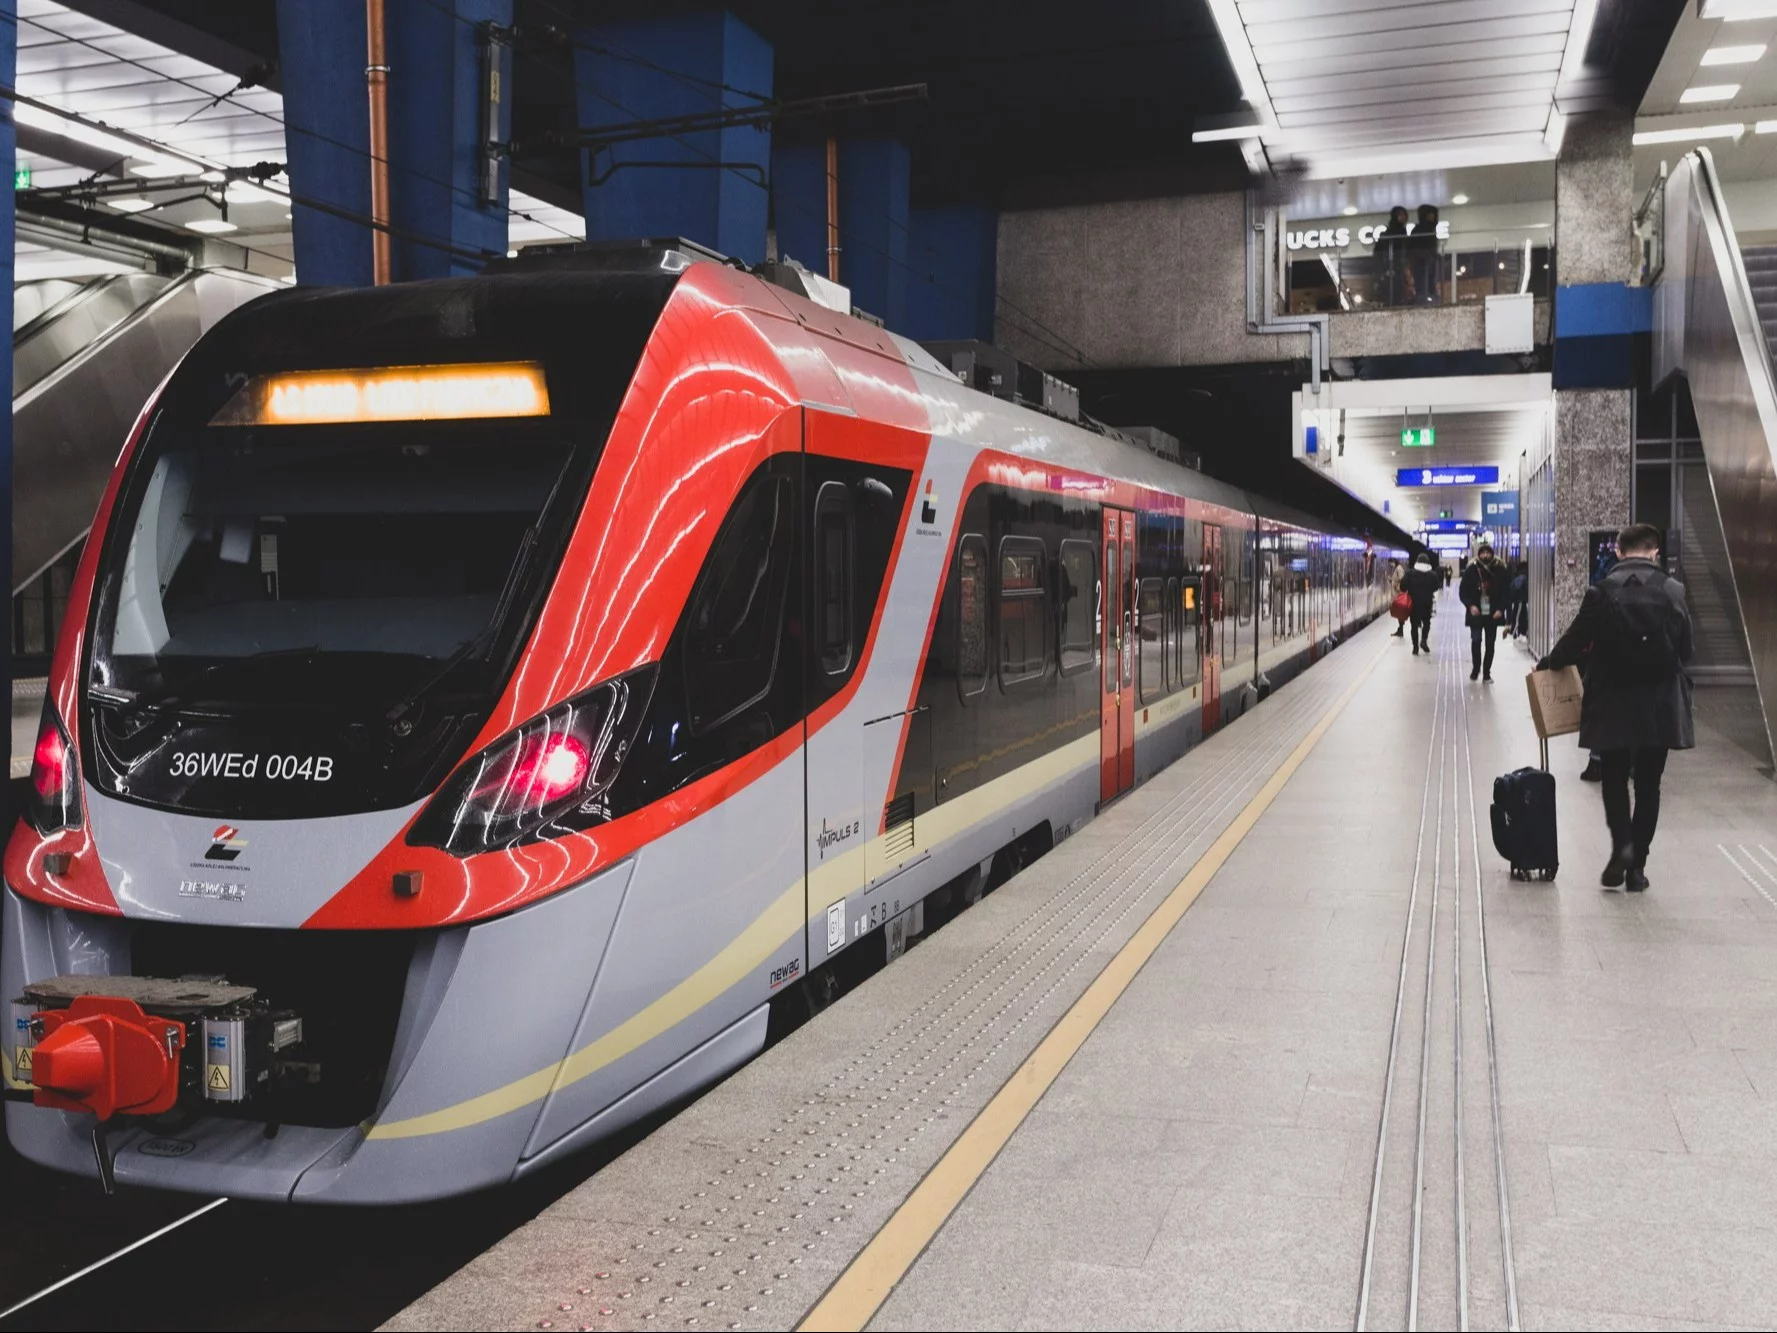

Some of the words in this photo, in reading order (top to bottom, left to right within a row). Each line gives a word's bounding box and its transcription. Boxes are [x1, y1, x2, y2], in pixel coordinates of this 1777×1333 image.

[1287, 228, 1350, 250] UCKS
[1096, 580, 1102, 620] 2
[169, 752, 259, 778] 36WEd
[265, 754, 334, 781] 004B
[853, 820, 860, 834] 2
